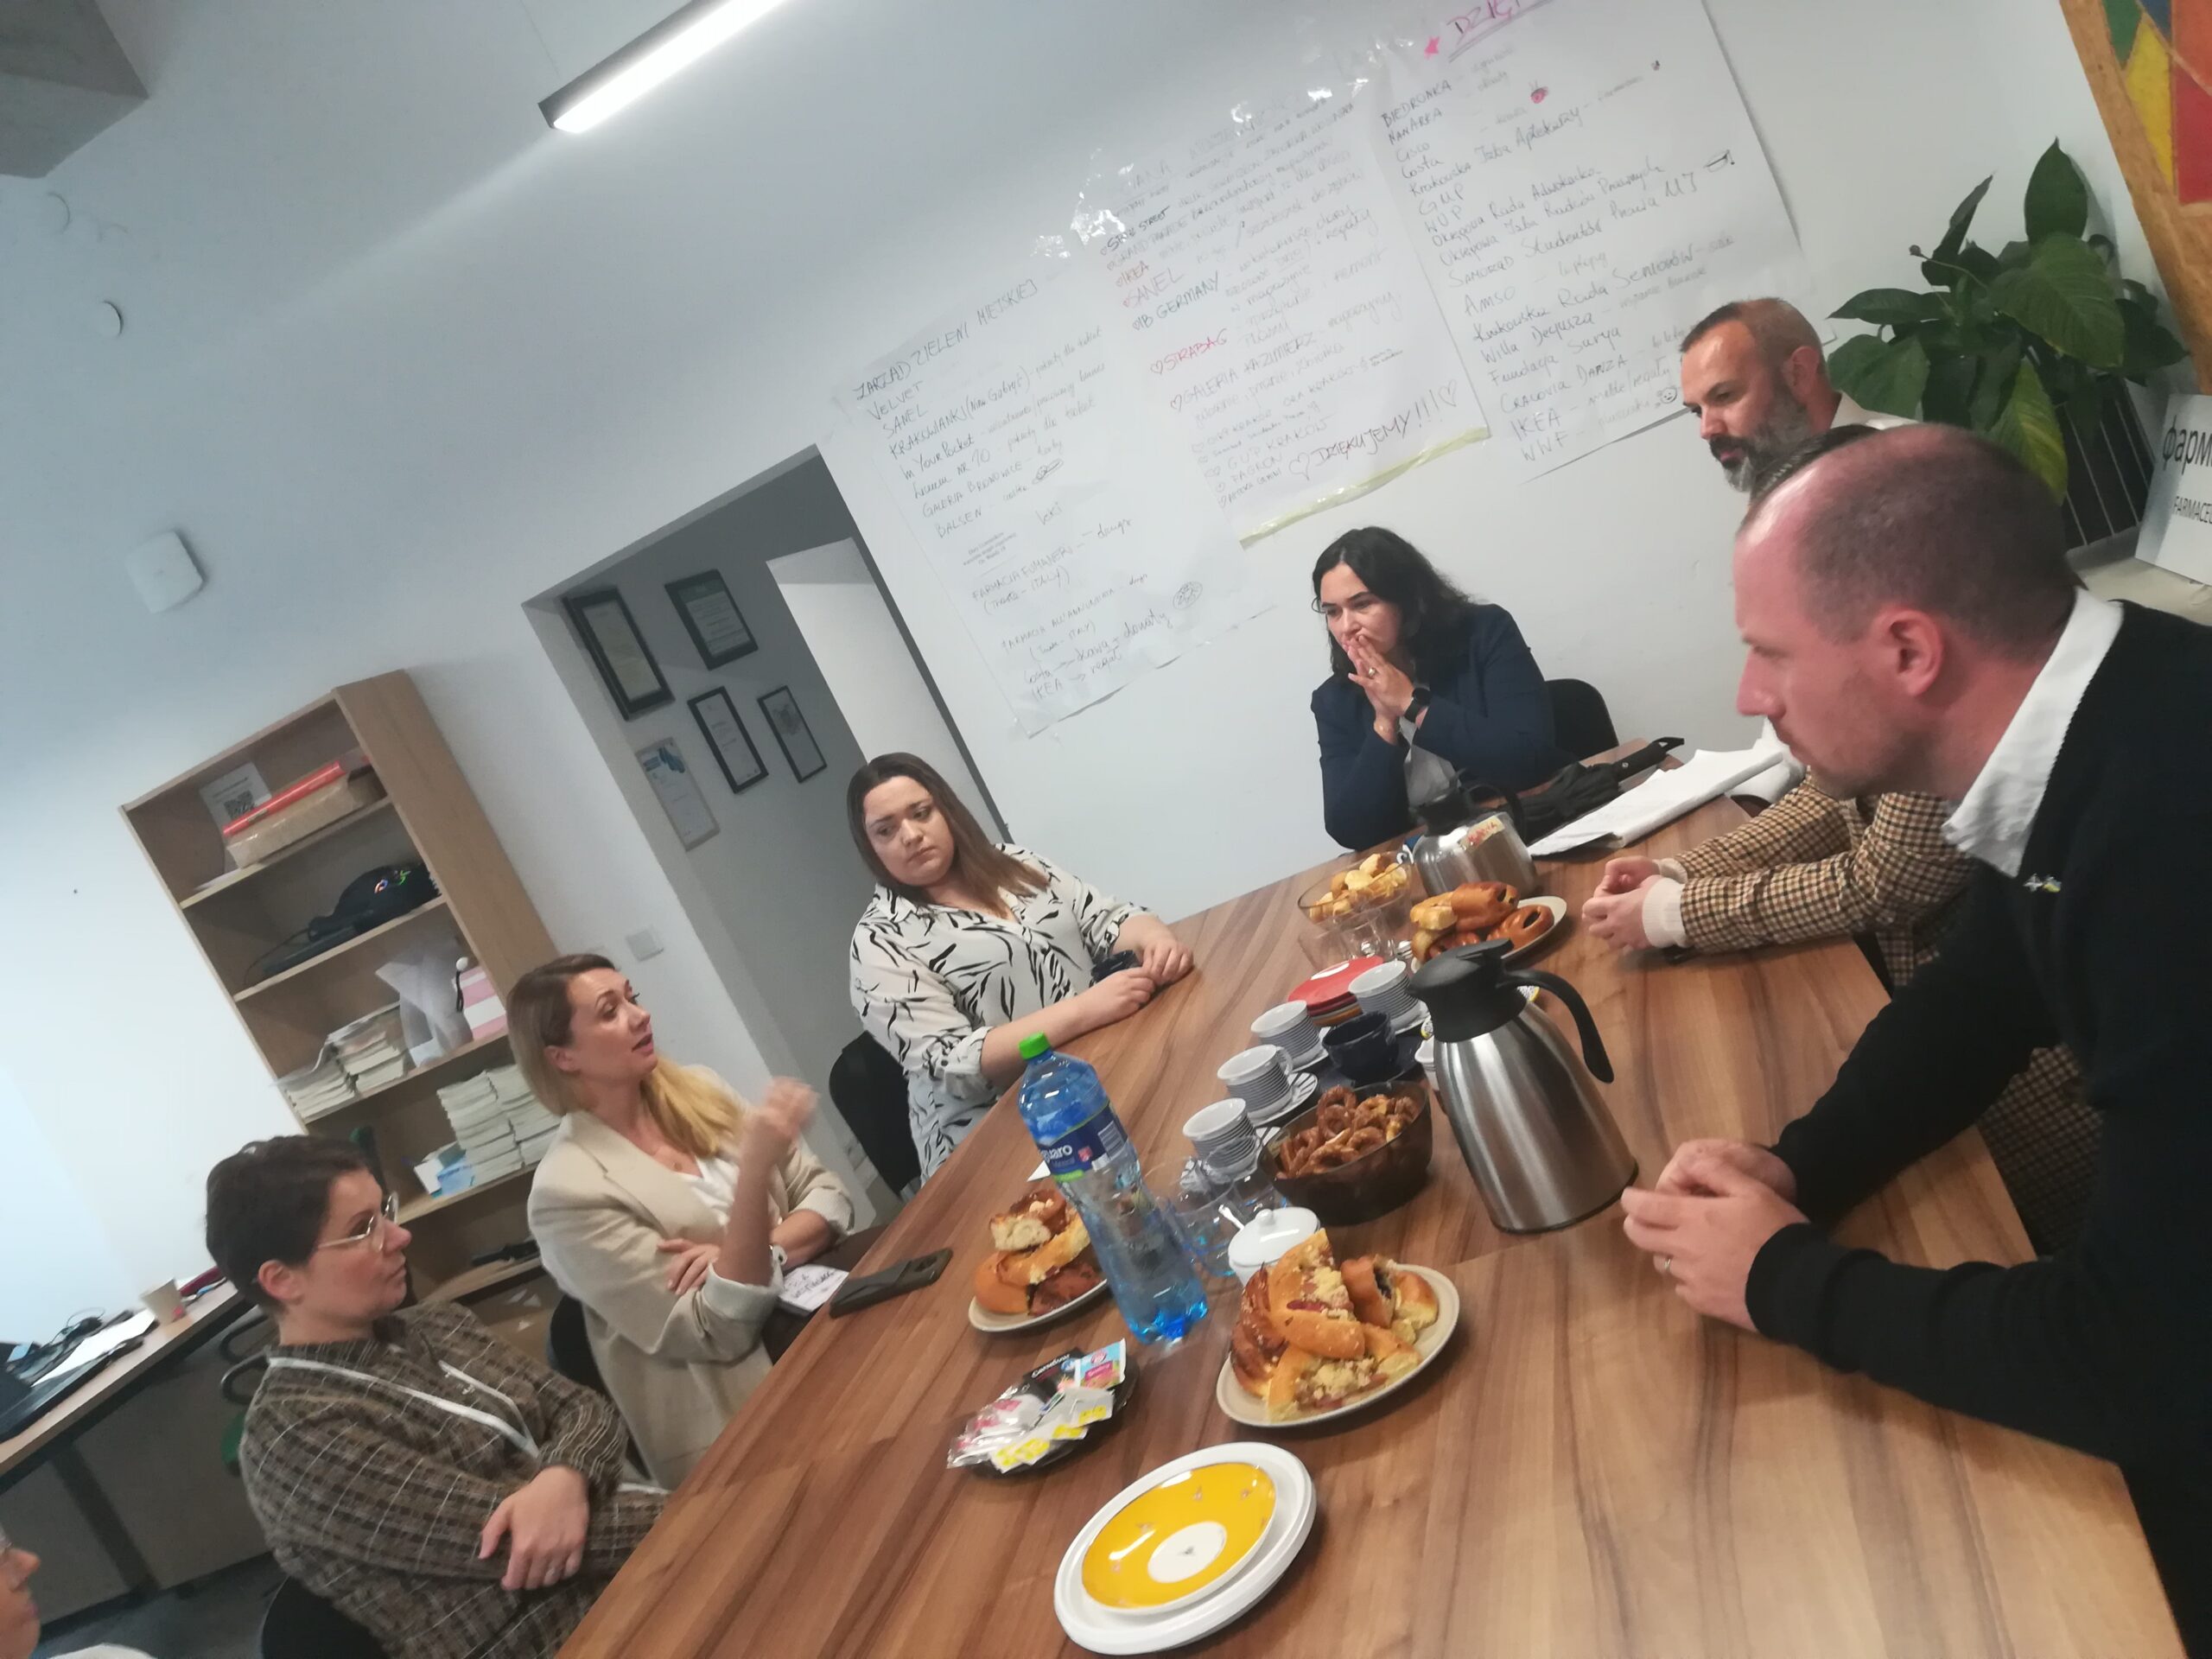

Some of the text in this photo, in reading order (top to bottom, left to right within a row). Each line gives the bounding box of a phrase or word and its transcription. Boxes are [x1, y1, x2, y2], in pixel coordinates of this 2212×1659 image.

[1381, 79, 1452, 128] BIEDRONKA
[1402, 156, 1444, 179] Costa
[1409, 162, 1471, 197] Krakowska
[1474, 143, 1512, 163] Izba
[1489, 196, 1526, 219] Rada
[1611, 196, 1659, 219] Prawa
[1503, 216, 1537, 235] Izba
[1121, 261, 1149, 285] IKEA
[1128, 267, 1185, 306] SANEL
[1156, 270, 1219, 319] GERMANY
[1558, 281, 1609, 308] Rada
[911, 321, 969, 366] ZIELENI
[976, 279, 1038, 326] MIEJSKIEJ
[1164, 327, 1227, 372] STRABAG
[1481, 340, 1519, 365] Willa
[1567, 327, 1622, 355] Surya
[1184, 367, 1238, 404] GALERIA
[1243, 332, 1316, 374] KAZIMIERZ
[867, 380, 925, 421] VELVET
[881, 403, 927, 439] SANEL
[1511, 408, 1561, 442] IKEA
[912, 451, 943, 472] Your
[941, 434, 976, 461] Pocket
[971, 448, 991, 467] 10
[2163, 415, 2212, 475] фарм
[922, 490, 964, 518] GALERIA
[967, 461, 1023, 493] BRONOWICE
[935, 505, 982, 539] BALSEN
[2173, 495, 2212, 524] FARMACE
[972, 569, 1021, 601] FARMACIA
[1001, 625, 1046, 655] FARMACIA
[1031, 678, 1064, 704] IKEA
